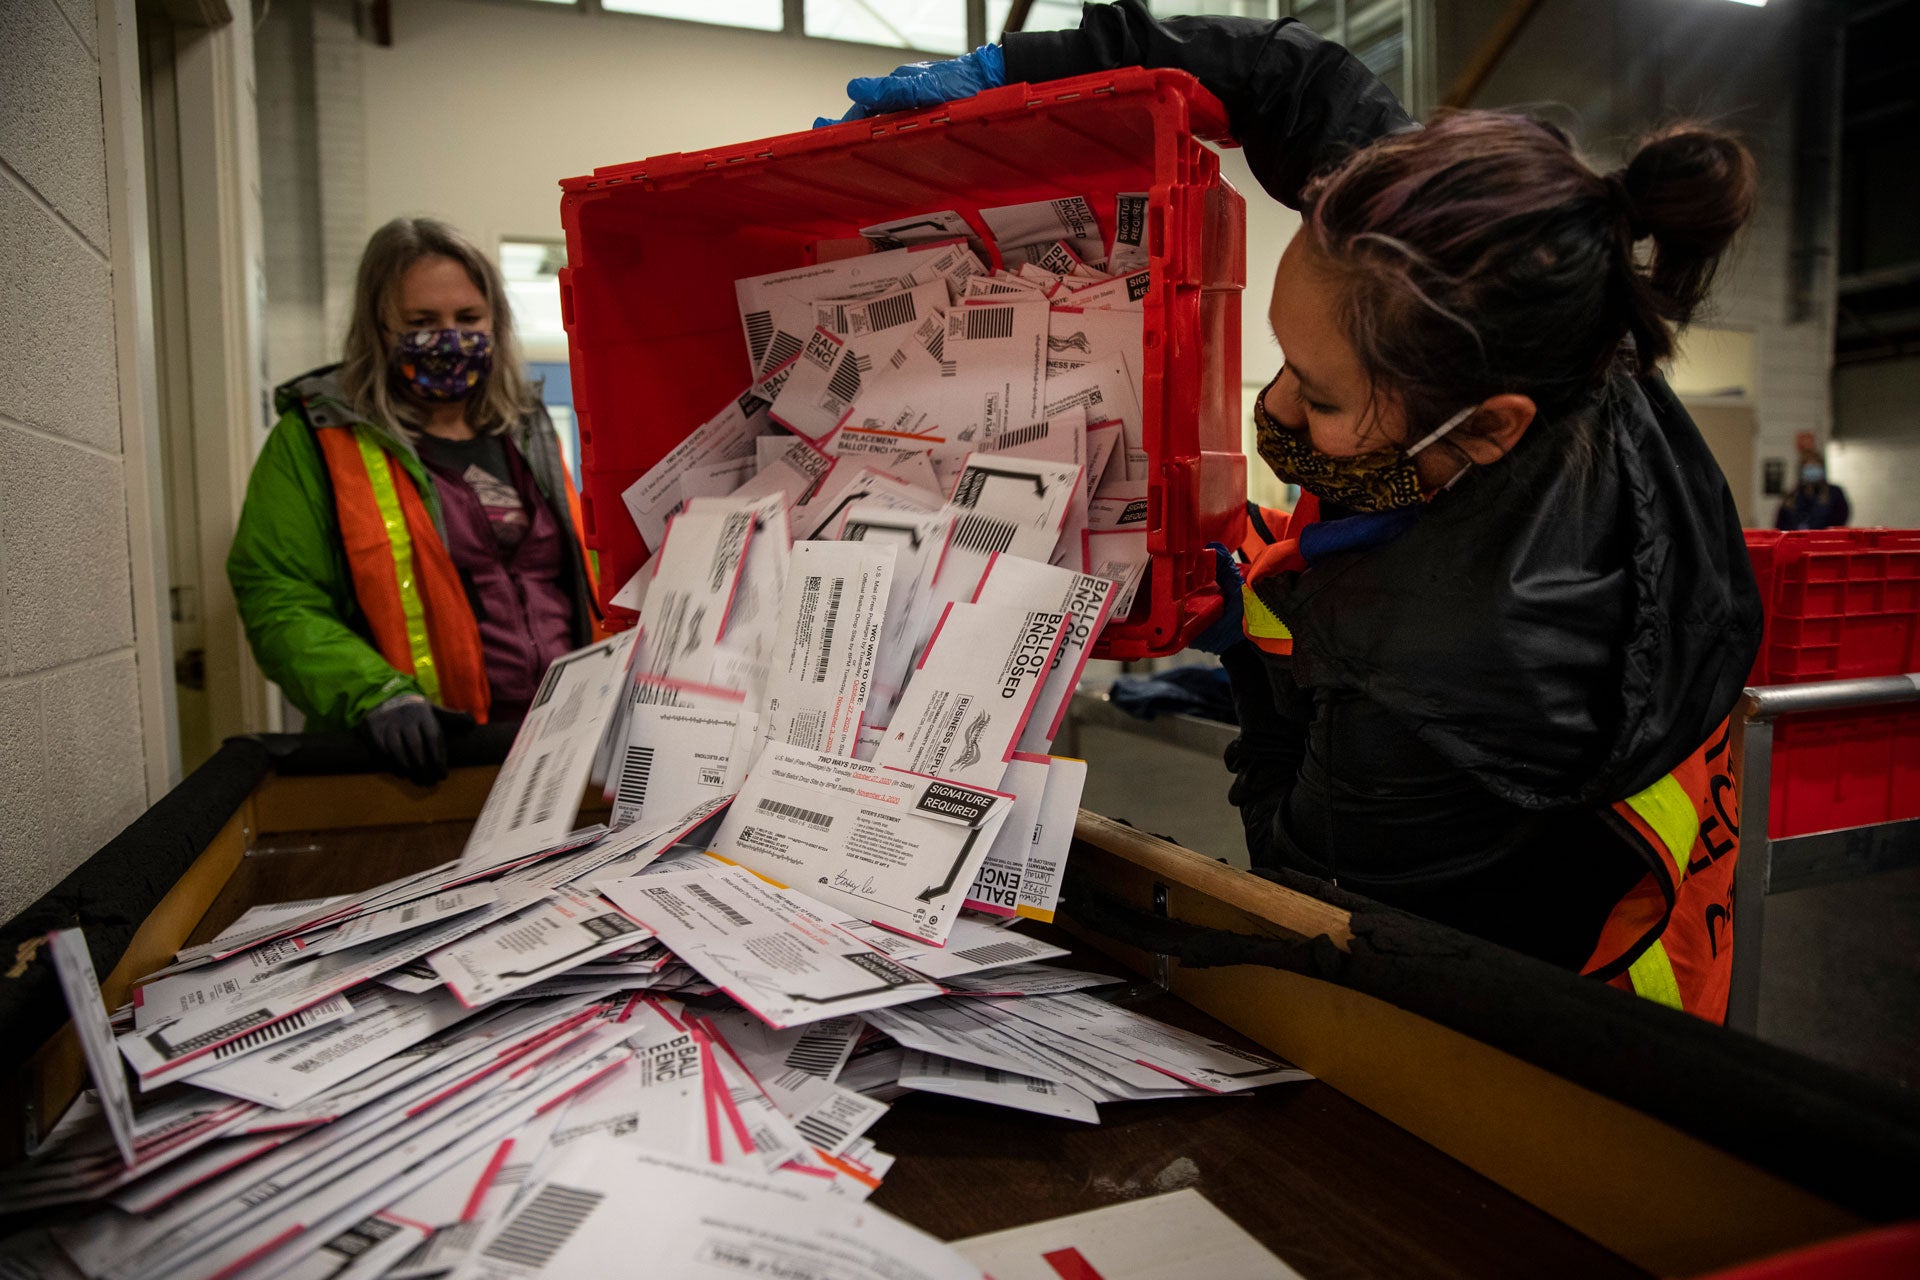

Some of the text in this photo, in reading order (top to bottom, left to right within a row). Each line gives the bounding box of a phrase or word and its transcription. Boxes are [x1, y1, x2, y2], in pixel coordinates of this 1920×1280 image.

[1058, 198, 1087, 239] ENCLOSED
[1071, 197, 1094, 224] BALLOT
[986, 396, 994, 416] MAIL
[838, 442, 868, 452] BALLOT
[841, 432, 899, 446] REPLACEMENT
[795, 442, 828, 469] BALLOT
[860, 572, 869, 594] Official
[856, 594, 865, 613] Ballot
[868, 595, 877, 612] (Free
[1071, 579, 1110, 650] BALLOT
[852, 613, 861, 629] Drop
[863, 612, 874, 642] Postage)
[1001, 612, 1049, 699] ENCLOSED
[1026, 613, 1063, 678] BALLOT
[856, 623, 878, 706] TWO WAYS TO VOTE:
[848, 679, 860, 705] October
[831, 696, 844, 728] November
[942, 698, 970, 745] BUSINESS
[922, 724, 935, 746] COUNTY
[694, 752, 718, 761] ELECTIONS
[817, 755, 877, 774] TWO WAYS TO VOTE:
[928, 745, 948, 777] REPLY
[702, 773, 721, 784] MAIL
[771, 769, 786, 778] Official
[786, 772, 799, 780] Ballot
[799, 775, 810, 784] Drop
[810, 777, 819, 785] Site
[825, 781, 838, 790] 8PM
[855, 788, 881, 801] November
[886, 795, 901, 805] 2020
[806, 761, 826, 773] Postage)
[852, 771, 872, 782] October
[878, 776, 892, 786] 2020
[891, 779, 899, 787] (In
[899, 781, 915, 791] State)
[923, 796, 979, 819] REQUIRED
[929, 783, 991, 808] SIGNATURE
[860, 808, 901, 823] VOTER'S STATEMENT
[967, 882, 1017, 907] BALL
